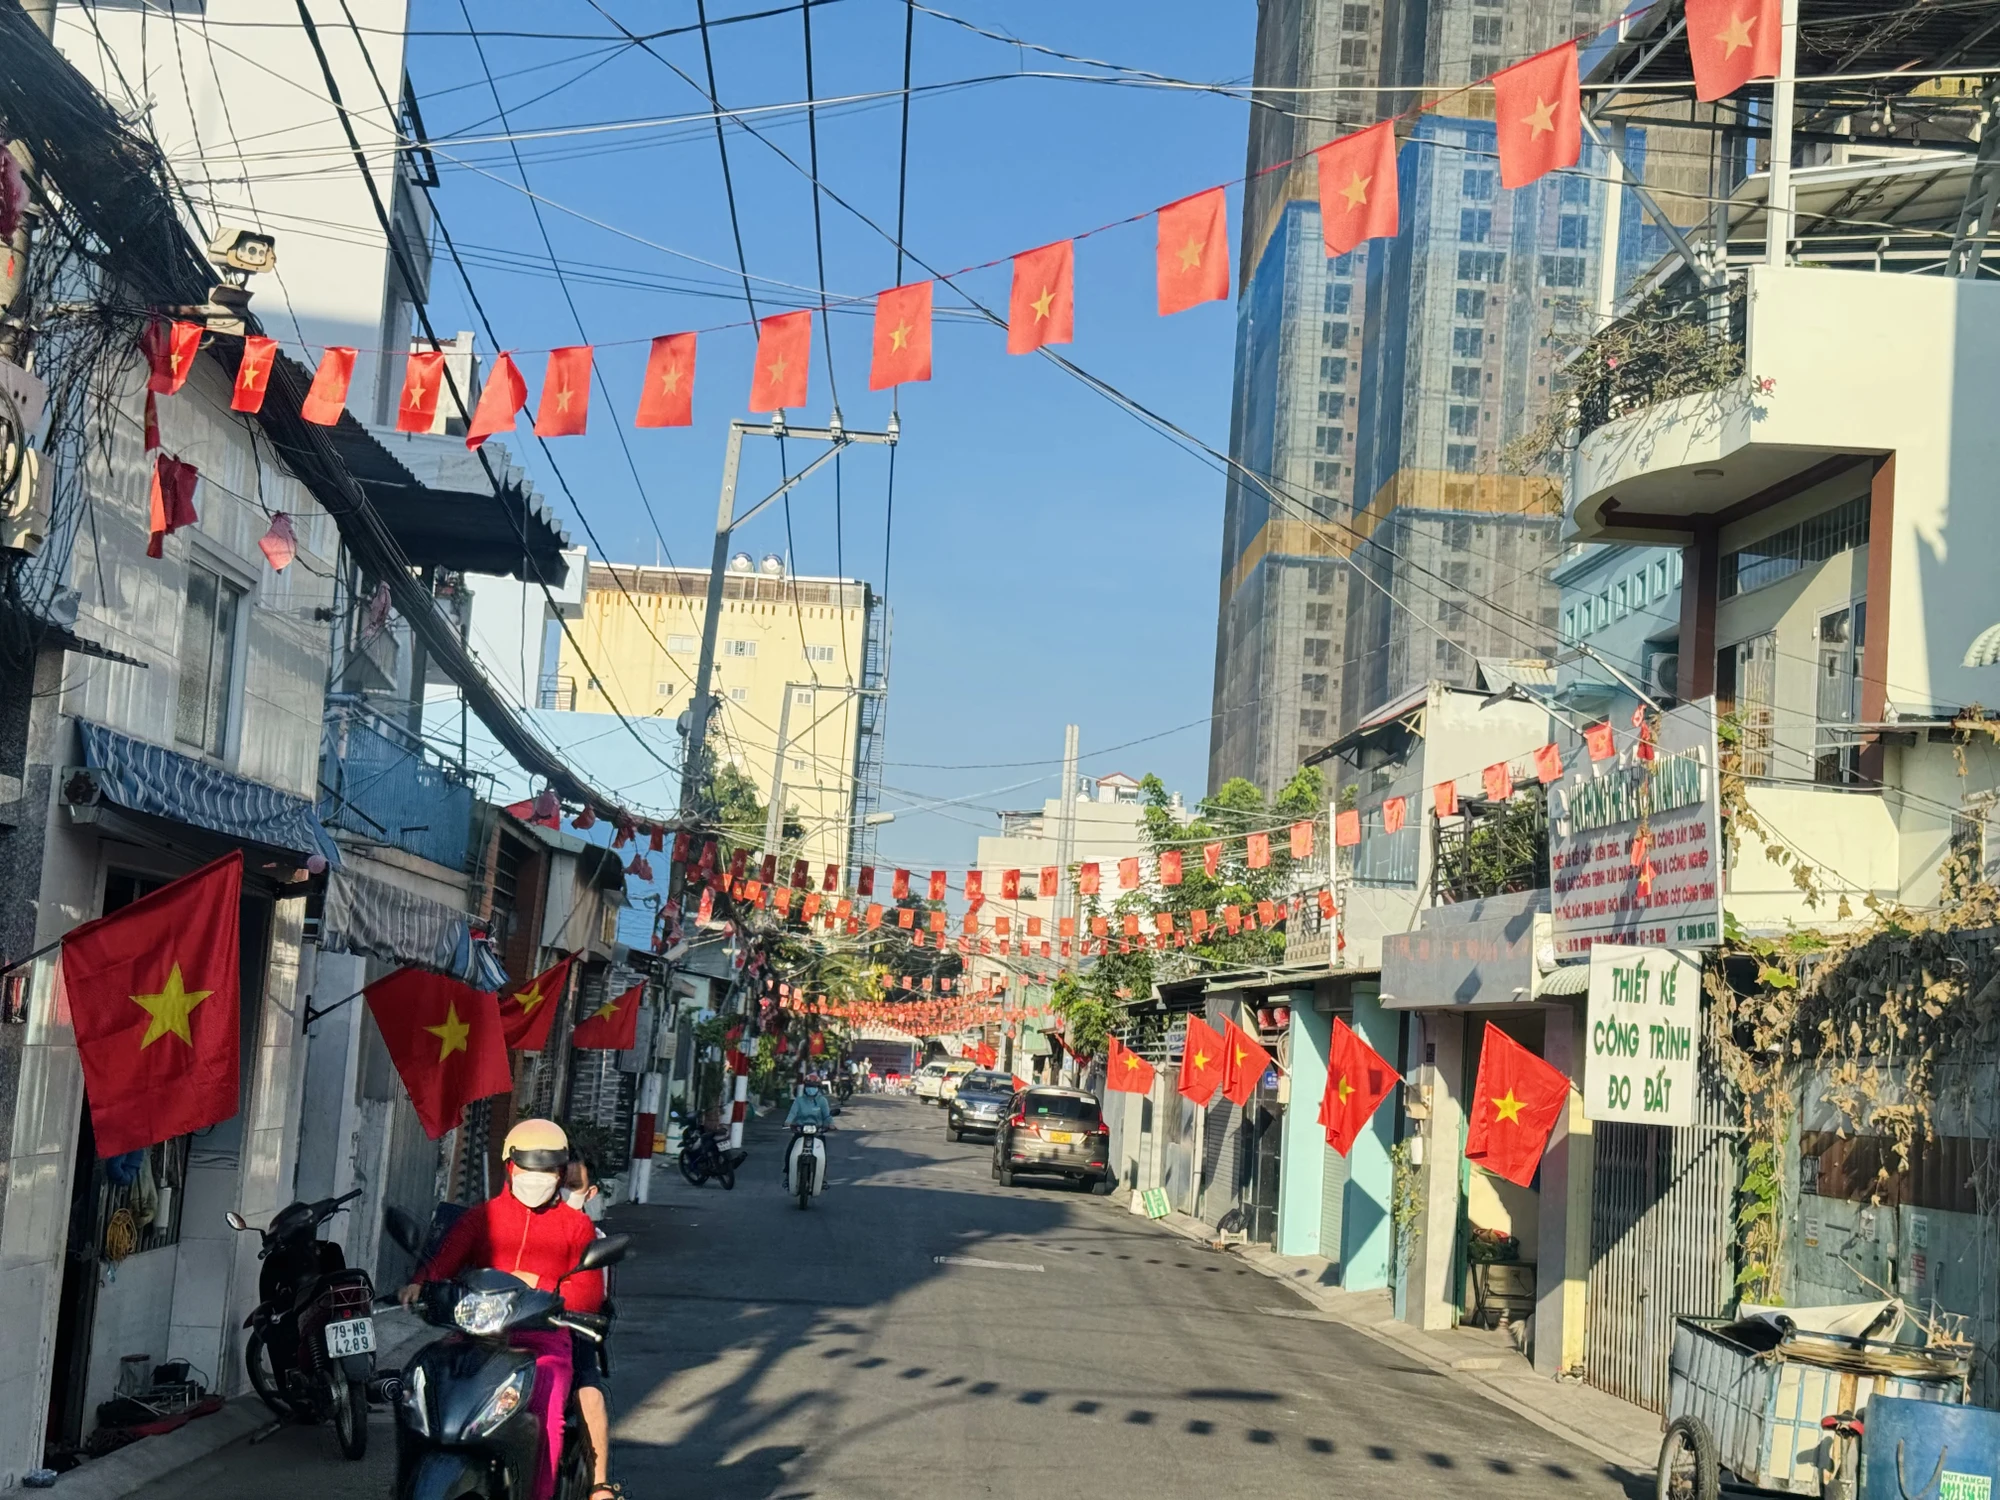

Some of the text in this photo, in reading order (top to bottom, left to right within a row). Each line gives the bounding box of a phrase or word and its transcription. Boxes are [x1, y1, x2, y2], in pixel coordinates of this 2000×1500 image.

[1657, 828, 1674, 848] CÔNG
[1676, 824, 1688, 843] XÂY
[1689, 822, 1706, 845] DỰNG
[1577, 870, 1591, 889] CÔNG
[1606, 865, 1617, 883] XÂY
[1618, 865, 1633, 885] DỰNG
[1669, 853, 1686, 872] CÔNG
[1612, 957, 1680, 1006] THIẾT KẾ
[1594, 1014, 1691, 1061] CÔNG TRÌNH
[1608, 1065, 1672, 1113] ĐO ĐẤT
[332, 1321, 366, 1340] 79-N9
[335, 1337, 369, 1354] 4289
